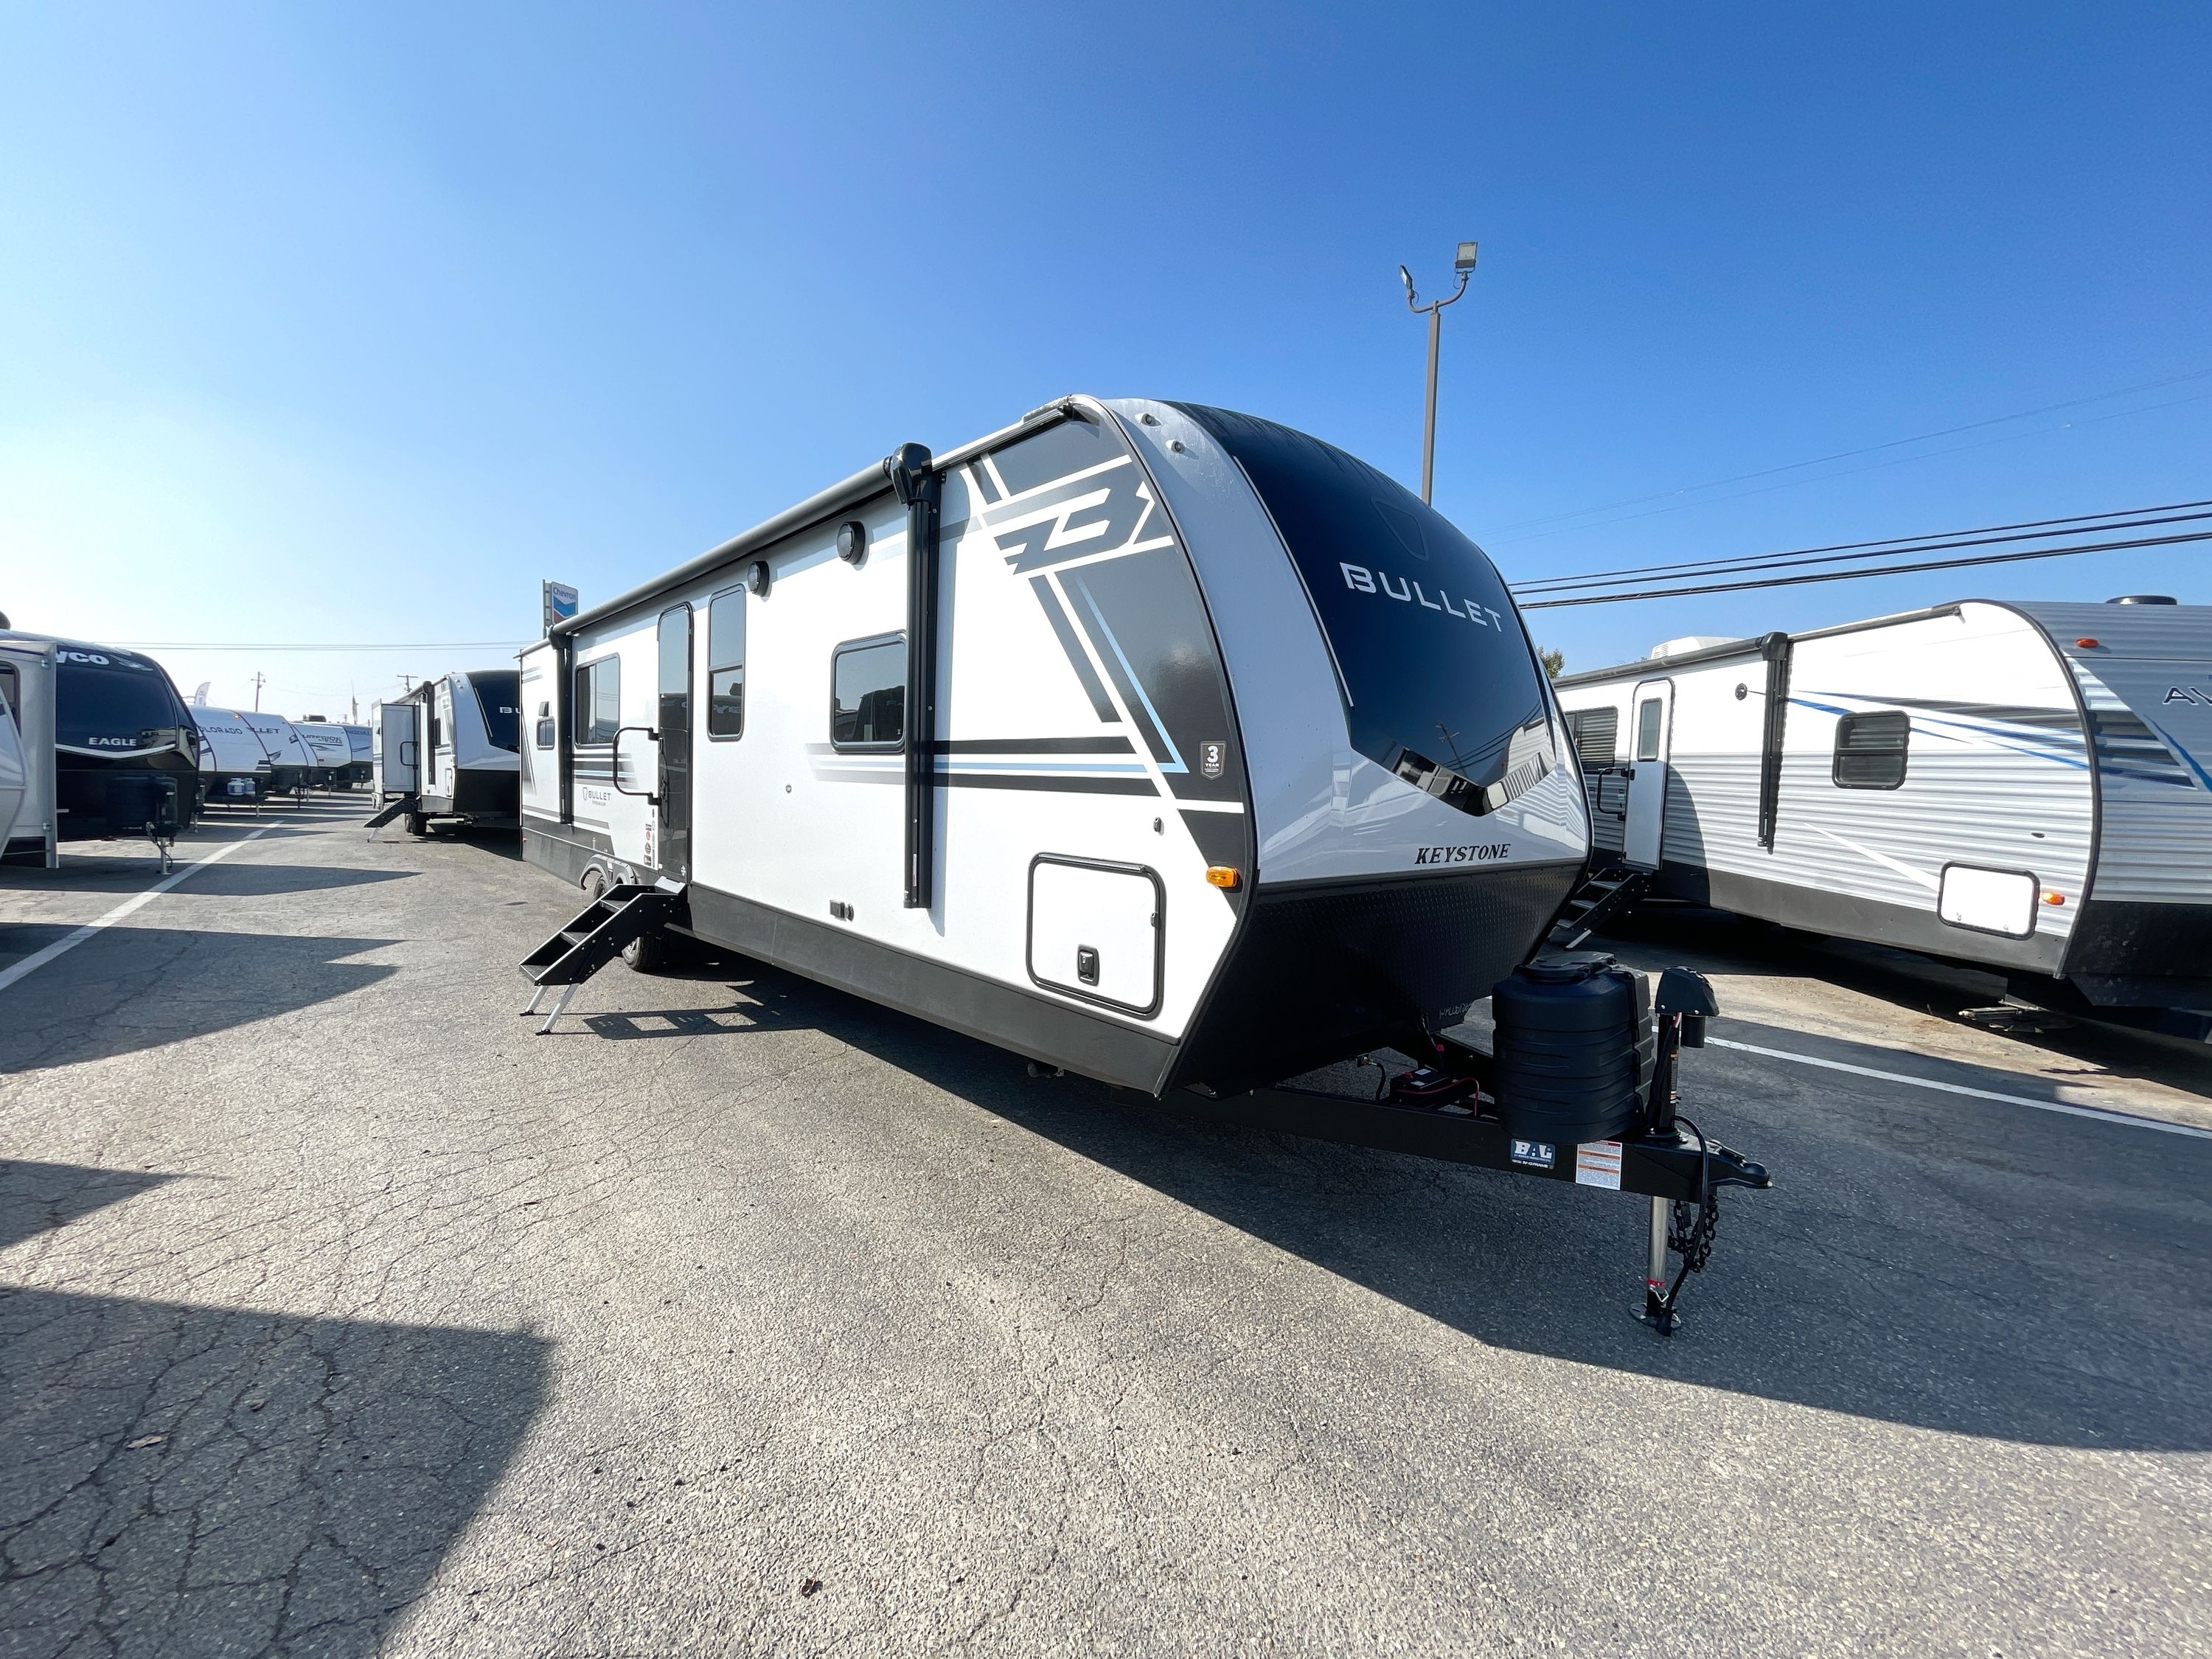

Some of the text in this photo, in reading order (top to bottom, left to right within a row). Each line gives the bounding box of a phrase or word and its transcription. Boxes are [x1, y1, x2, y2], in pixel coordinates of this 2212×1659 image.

[553, 587, 577, 599] Chevron
[1339, 562, 1502, 633] BULLET
[88, 737, 137, 747] EAGLE
[1207, 745, 1219, 763] 3
[588, 790, 611, 801] BULLET
[1414, 844, 1511, 864] KEYSTONE
